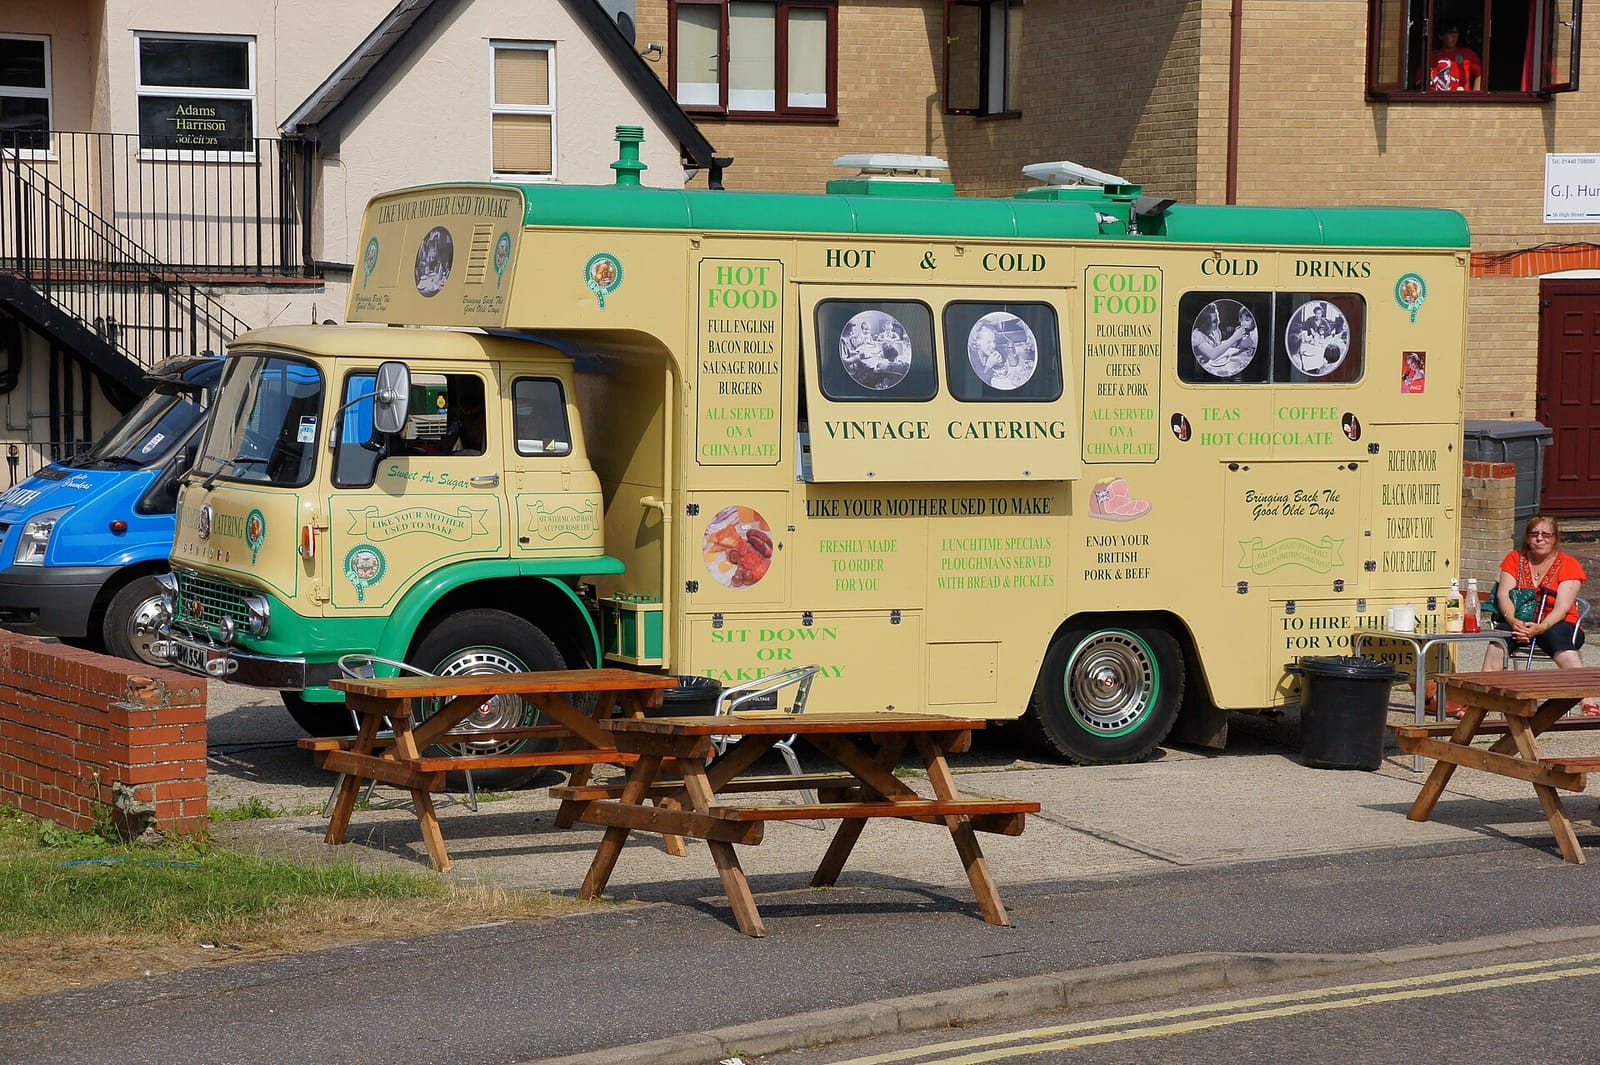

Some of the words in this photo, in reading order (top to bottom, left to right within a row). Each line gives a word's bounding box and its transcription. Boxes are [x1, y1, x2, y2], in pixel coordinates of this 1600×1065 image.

[175, 104, 216, 116] Adams
[176, 119, 226, 131] Harrison
[175, 134, 218, 145] Solicitors
[1551, 184, 1573, 200] G.J.
[378, 204, 397, 224] LIKE
[398, 201, 418, 221] YOUR
[420, 196, 451, 218] MOTHER
[452, 196, 472, 215] USED
[474, 197, 485, 216] TO
[826, 249, 876, 268] HOT
[920, 251, 937, 270] &
[982, 252, 1046, 272] COLD
[1201, 258, 1259, 276] COLD
[1295, 260, 1371, 278] DRINKS
[717, 266, 770, 286] HOT
[1093, 273, 1158, 292] COLD
[708, 288, 778, 309] FOOD
[1093, 295, 1158, 314] FOOD
[708, 320, 732, 333] FULL
[734, 320, 774, 334] ENGLISH
[1096, 324, 1152, 337] PLOUGHMANS
[708, 340, 741, 354] BACON
[744, 340, 774, 354] ROLLS
[1088, 344, 1106, 357] HAM
[1108, 344, 1119, 357] ON
[1121, 344, 1136, 357] THE
[1138, 344, 1160, 357] BONE
[703, 360, 746, 374] SAUSAGE
[748, 361, 778, 374] ROLLS
[1106, 363, 1141, 376] CHEESES
[719, 381, 762, 394] BURGERS
[1097, 383, 1118, 396] BEEF
[1118, 384, 1124, 396] &
[1126, 383, 1148, 396] PORK
[706, 407, 728, 420] ALL
[730, 407, 774, 420] SERVED
[1091, 408, 1112, 420] ALL
[1113, 408, 1154, 420] SERVED
[1201, 408, 1241, 420] TEAS
[1278, 406, 1338, 420] COFFEE
[726, 426, 742, 438] ON
[745, 426, 753, 438] A
[825, 420, 930, 440] VINTAGE
[947, 420, 1066, 440] CATERING
[1109, 426, 1124, 438] ON
[1127, 426, 1134, 438] A
[1201, 432, 1234, 446] HOT
[1237, 432, 1333, 446] CHOCOLATE
[702, 444, 738, 456] CHINA
[741, 444, 776, 456] PLATE
[1087, 443, 1120, 455] CHINA
[1123, 443, 1155, 455] PLATE
[1388, 450, 1406, 472] RICH
[1406, 450, 1416, 472] OR
[1418, 450, 1436, 472] POOR
[388, 465, 418, 480] Sweet
[420, 470, 434, 483] As
[438, 474, 468, 490] Sugar
[1246, 490, 1288, 507] Bringing
[1294, 490, 1318, 502] Back
[1322, 490, 1340, 502] The
[1382, 484, 1406, 505] BLACK
[1406, 484, 1416, 505] OR
[1418, 484, 1440, 504] WHITE
[843, 499, 882, 517] YOUR
[886, 498, 947, 516] MOTHER
[951, 498, 986, 516] USED
[989, 498, 1008, 515] TO
[1253, 504, 1280, 521] Good
[1282, 504, 1305, 516] Olde
[1309, 503, 1336, 519] Days
[214, 512, 243, 538] CATERING
[372, 518, 393, 529] LIKE
[395, 512, 422, 523] YOUR
[425, 512, 465, 528] MOTHER
[384, 523, 408, 536] USED
[1387, 518, 1396, 539] TO
[1397, 518, 1419, 538] SERVE
[1420, 517, 1434, 538] YOU
[820, 540, 864, 552] FRESHLY
[868, 540, 896, 552] MADE
[942, 538, 1002, 552] LUNCHTIME
[1005, 537, 1052, 550] SPECIALS
[1086, 535, 1119, 548] ENJOY
[1121, 534, 1150, 546] YOUR
[941, 556, 1012, 570] PLOUGHMANS
[1014, 556, 1052, 569] SERVED
[1097, 552, 1138, 564] BRITISH
[1383, 551, 1390, 572] IS
[1390, 551, 1405, 572] OUR
[1406, 550, 1437, 572] DELIGHT
[832, 559, 846, 572] TO
[848, 559, 884, 572] ORDER
[1084, 570, 1112, 580] PORK
[1114, 569, 1122, 580] &
[1125, 568, 1150, 580] BEEF
[836, 578, 856, 592] FOR
[858, 578, 880, 592] YOU
[938, 576, 964, 590] WITH
[967, 576, 1000, 589] BREAD
[1002, 576, 1010, 588] &
[1013, 574, 1055, 588] PICKLES
[1280, 618, 1304, 630] TO
[1310, 616, 1350, 629] HIRE
[1356, 614, 1386, 630] THI
[712, 629, 751, 644] SIT
[759, 628, 838, 642] DOWN
[1286, 636, 1320, 648] FOR
[1325, 635, 1374, 648] YOUR
[756, 648, 792, 662] OR
[702, 667, 770, 680] TAKE
